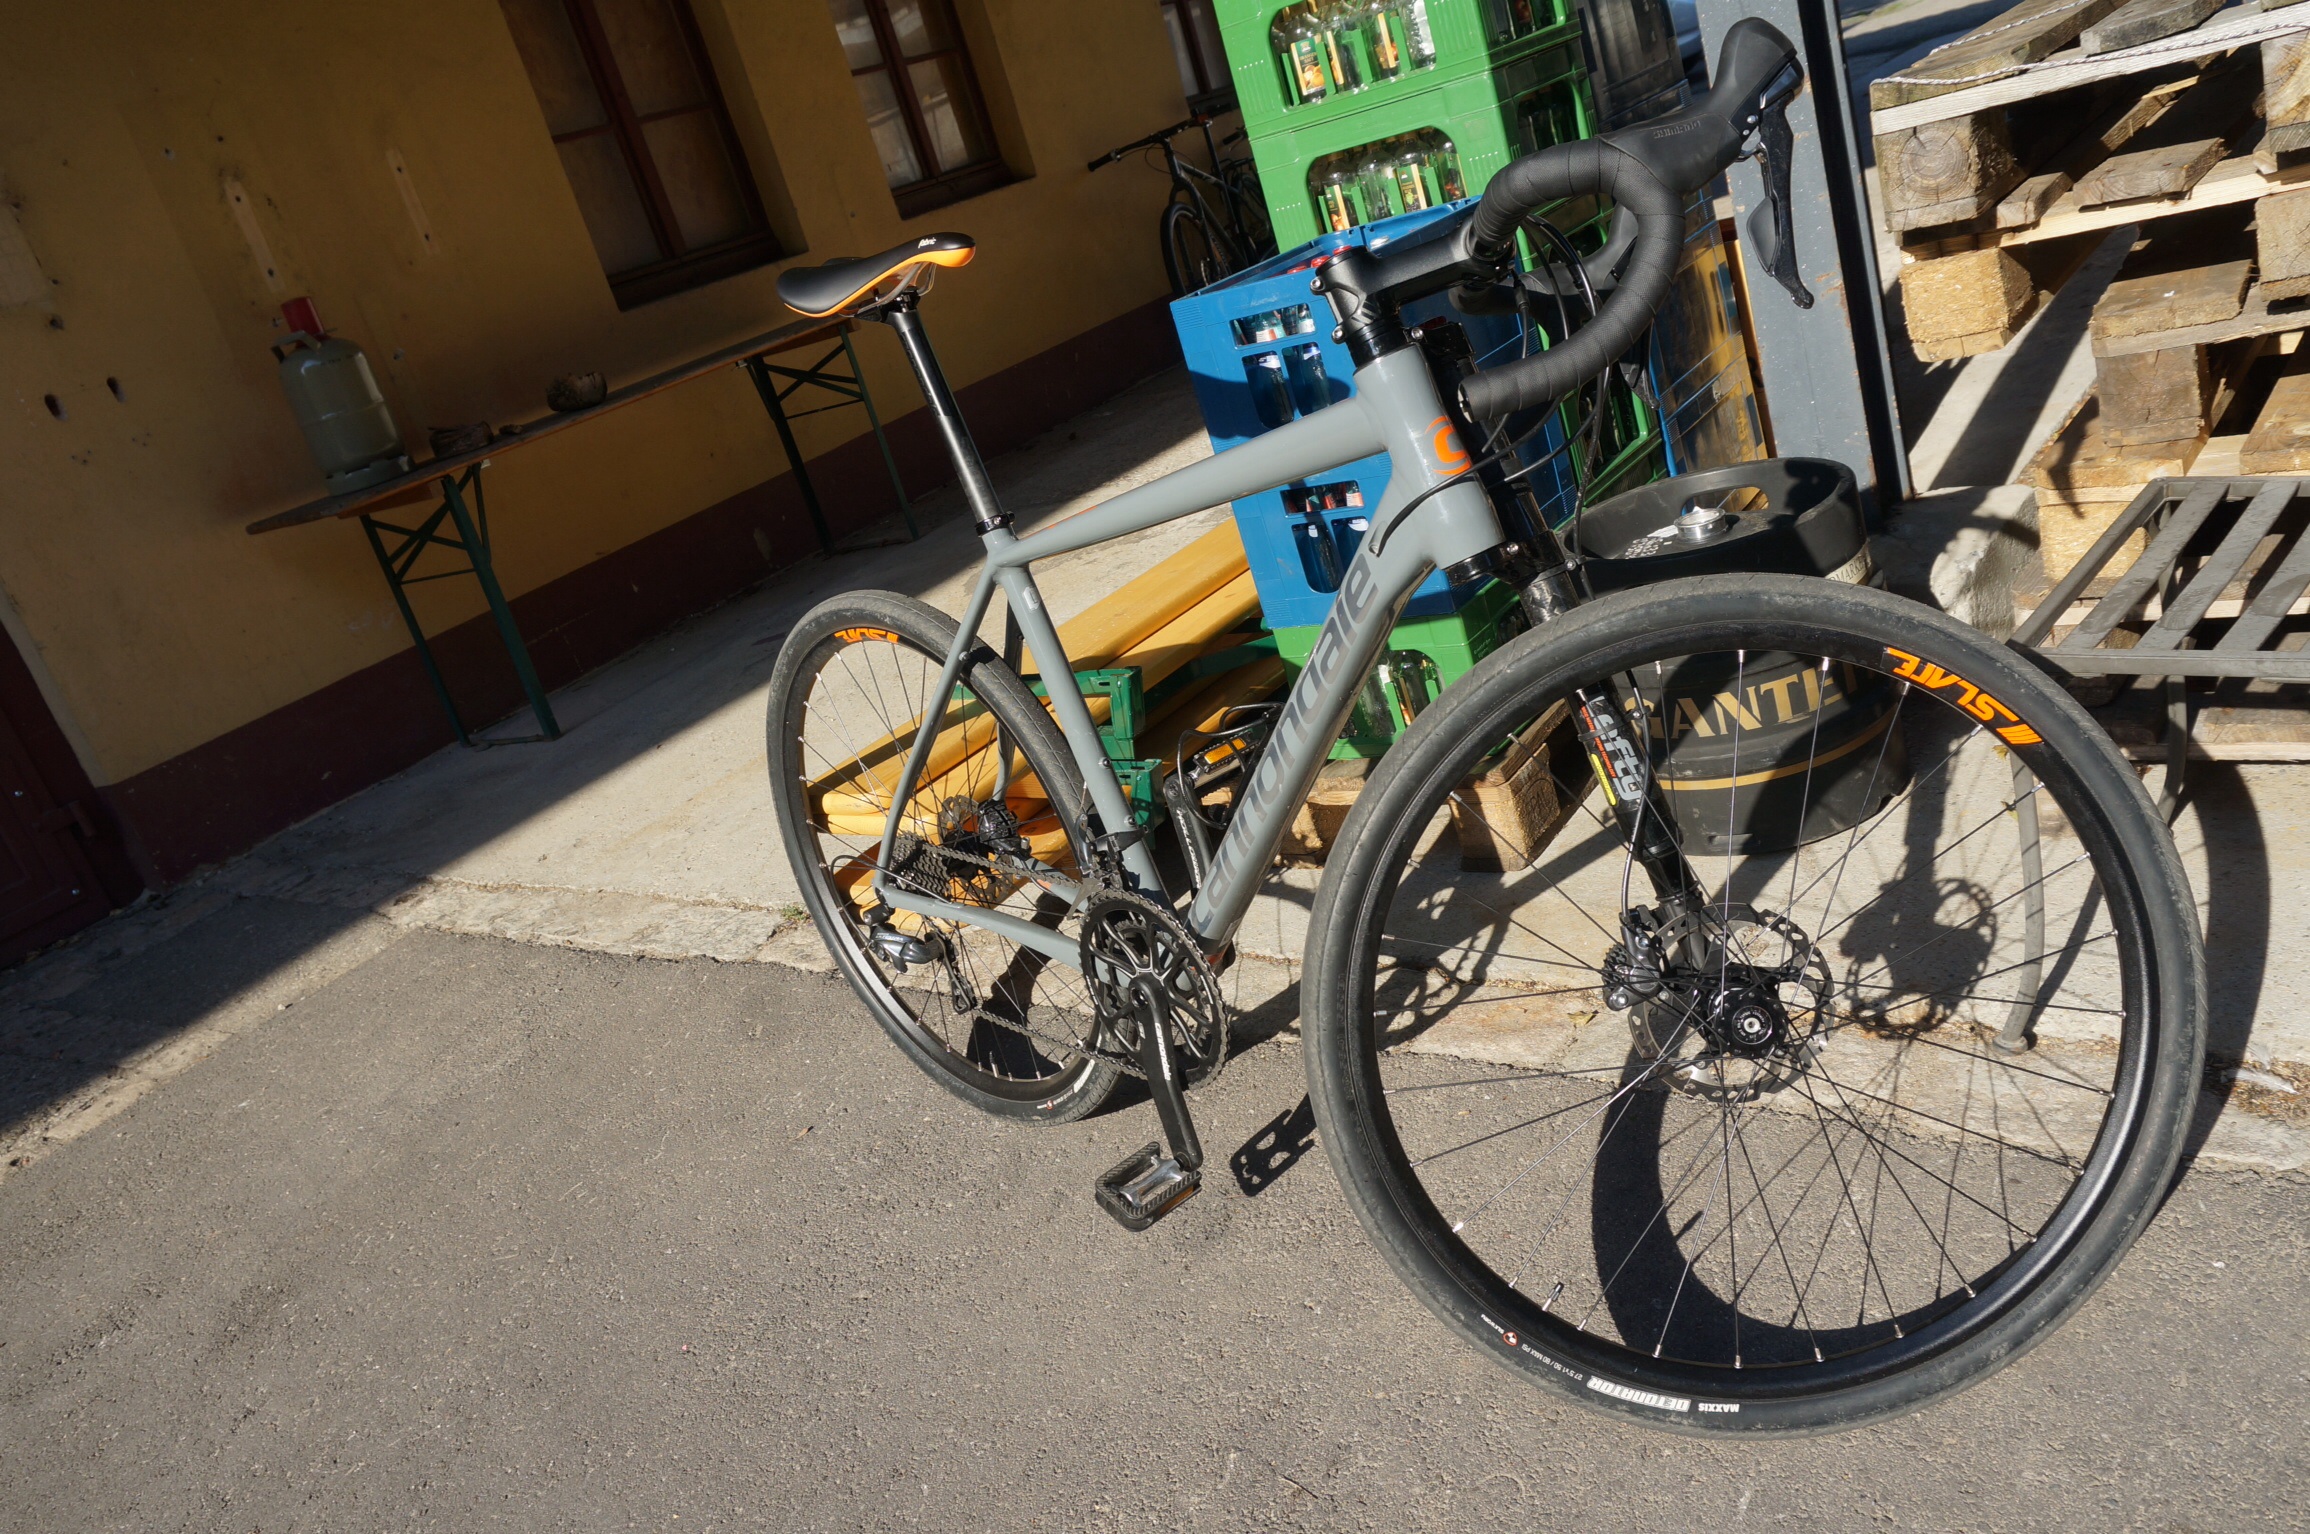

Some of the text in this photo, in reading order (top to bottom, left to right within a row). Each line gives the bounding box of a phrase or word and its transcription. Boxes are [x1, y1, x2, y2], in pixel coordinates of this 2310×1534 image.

[1887, 646, 2020, 722] SLATE
[1187, 553, 1380, 930] cannondale
[1587, 1375, 1740, 1413] MAXXIS DETONATOR
